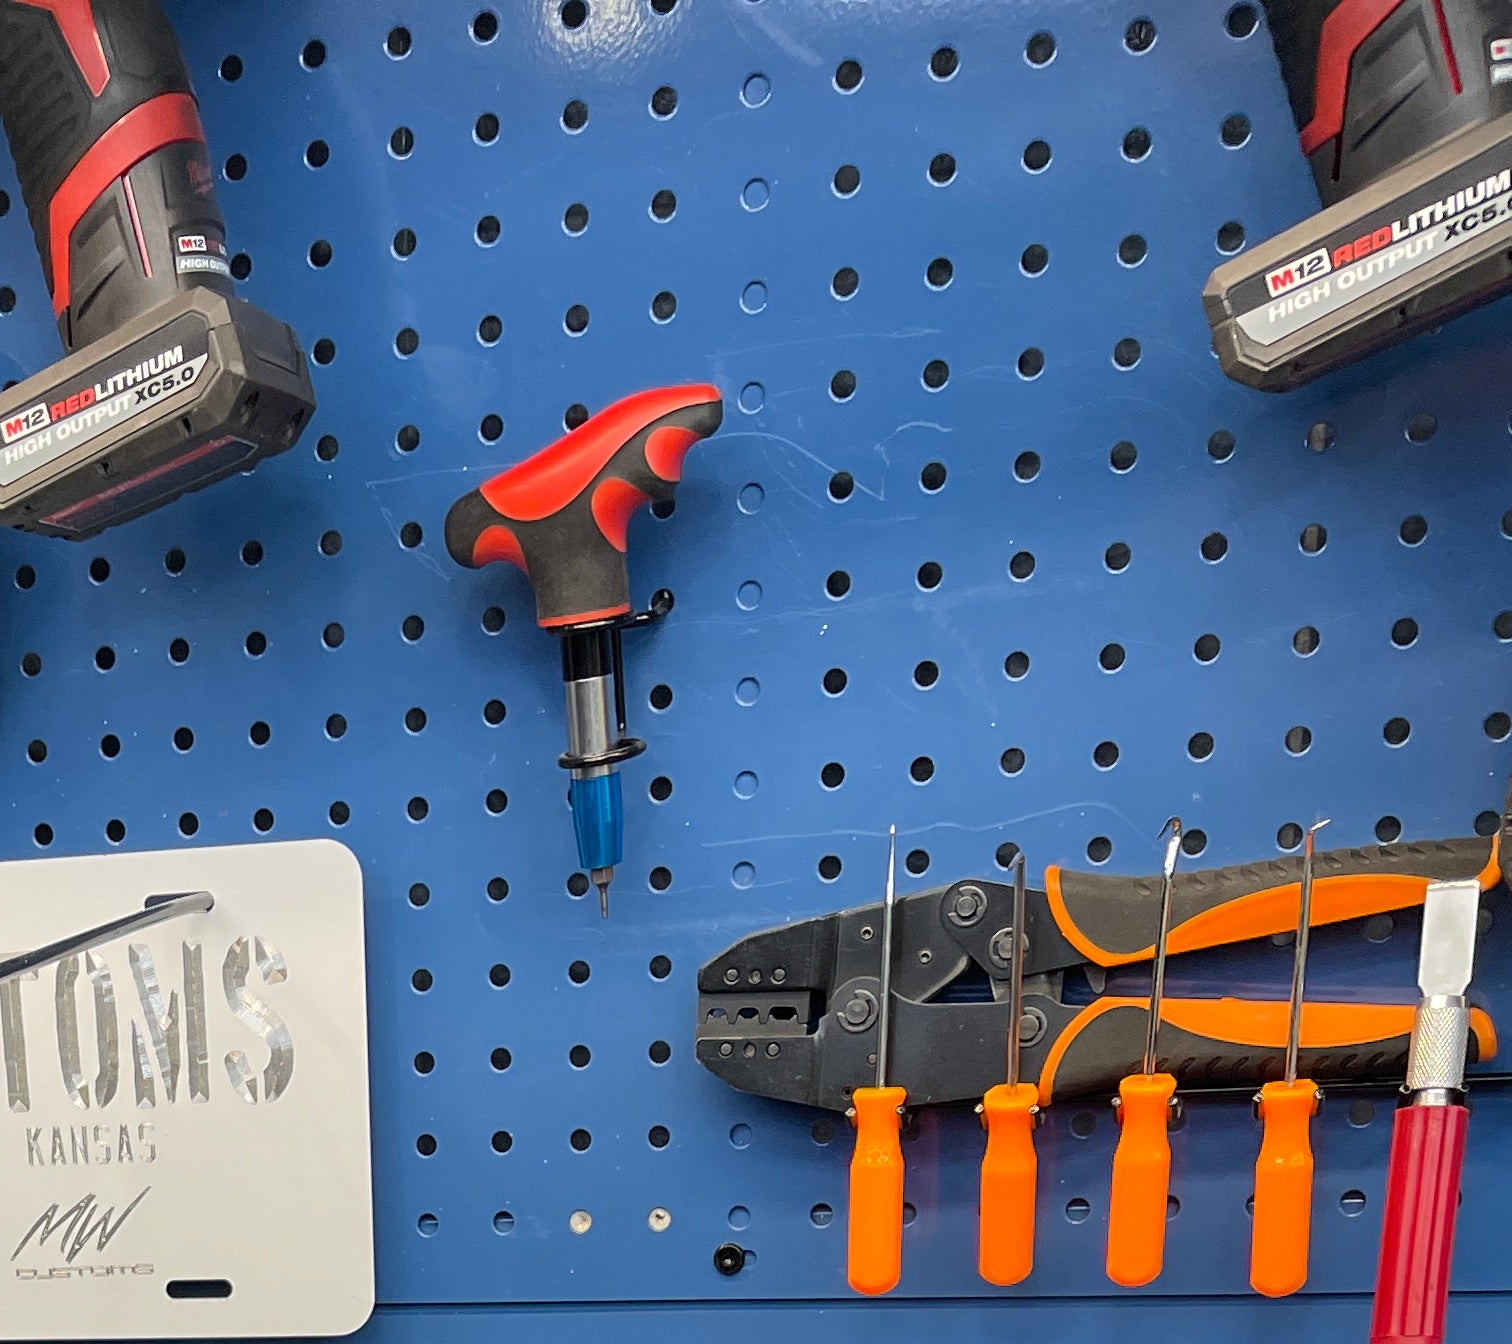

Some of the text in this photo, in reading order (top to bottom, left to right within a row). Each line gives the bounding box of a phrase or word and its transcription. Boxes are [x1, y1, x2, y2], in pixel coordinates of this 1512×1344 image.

[180, 258, 209, 269] HIGH
[181, 238, 205, 250] M12
[1271, 168, 1512, 291] M12 REDLITHIUM
[1269, 282, 1331, 323] HIGH
[1338, 231, 1439, 290] OUTPUT
[5, 346, 184, 438] M12 REDLITHIUM
[5, 366, 194, 465] HIGH OUTPUT XC5.0
[25, 1121, 157, 1168] KANSAS
[10, 1185, 152, 1264] MW
